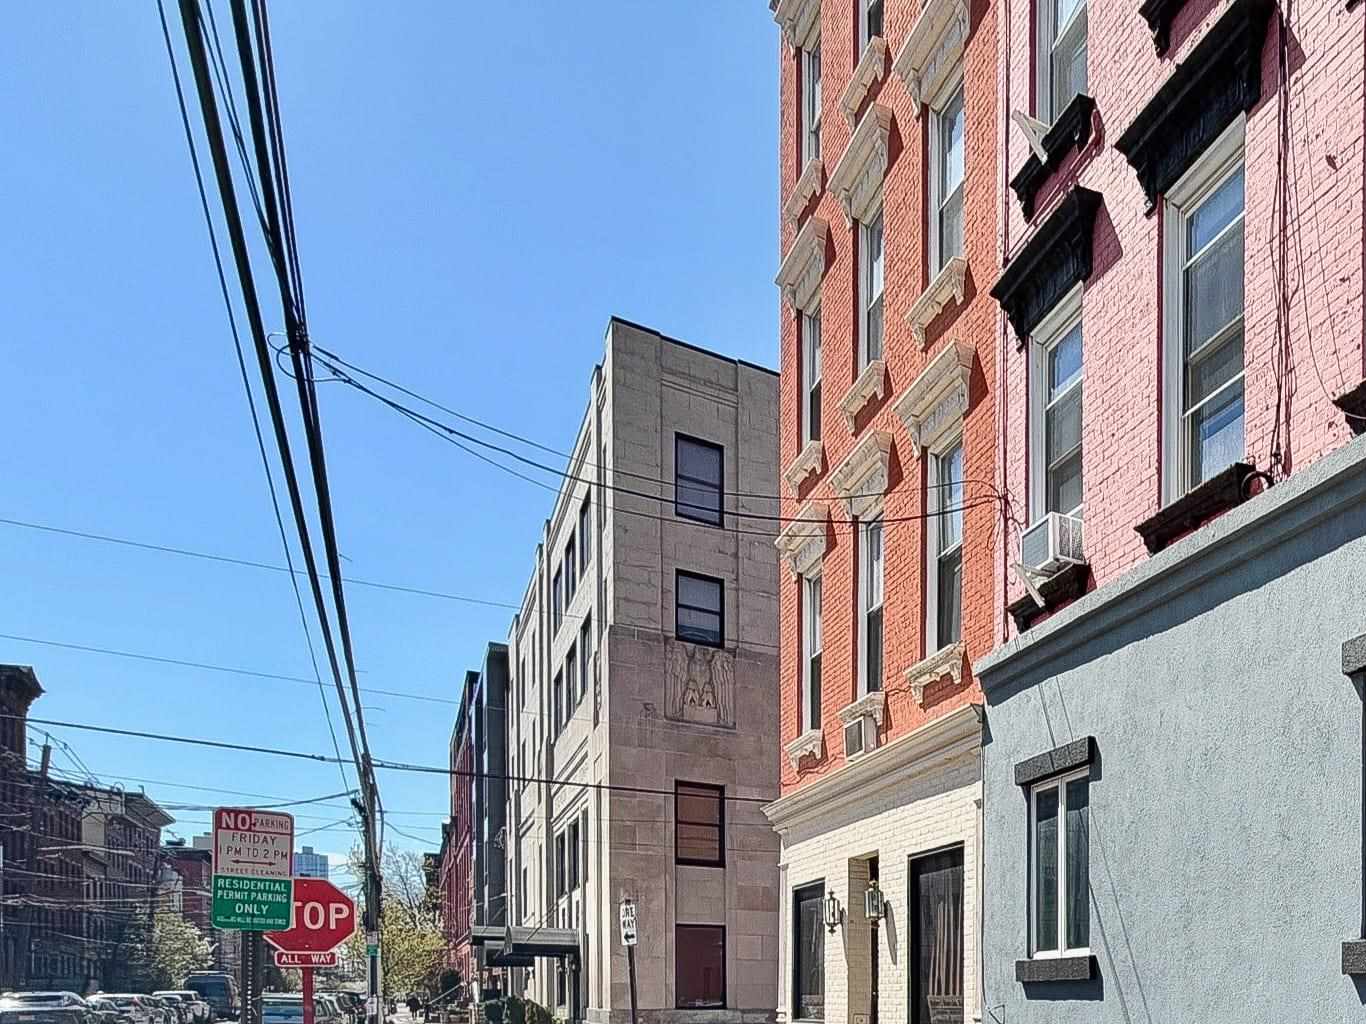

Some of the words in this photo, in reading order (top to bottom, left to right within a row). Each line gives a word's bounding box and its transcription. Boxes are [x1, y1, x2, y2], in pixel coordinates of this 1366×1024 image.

[221, 812, 251, 830] NO
[255, 818, 289, 831] PARKING
[231, 832, 277, 845] FRIDAY
[226, 846, 242, 857] PM
[247, 848, 259, 858] TO
[263, 850, 270, 859] 2
[273, 851, 288, 860] PM
[217, 878, 288, 892] RESIDENTIAL
[217, 889, 249, 900] PERMIT
[250, 891, 288, 903] PARKING
[235, 902, 269, 915] ONLY
[292, 901, 350, 930] TOP
[280, 953, 302, 964] ALL
[310, 953, 332, 964] WAY
